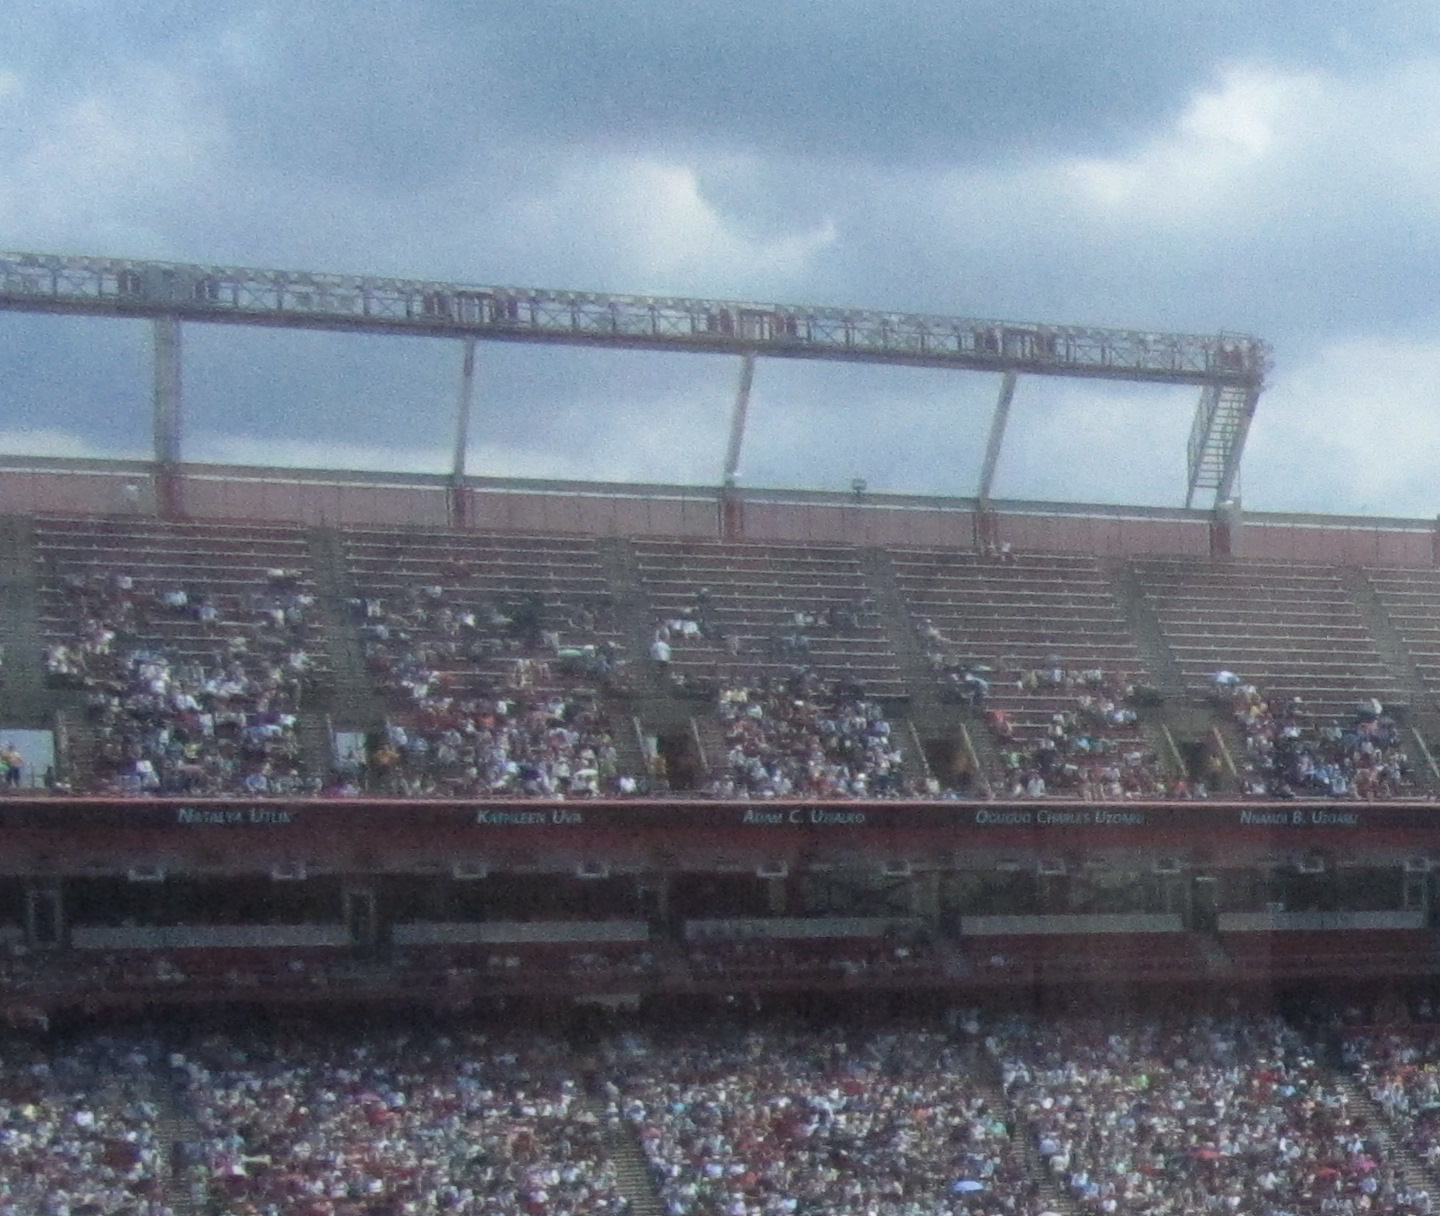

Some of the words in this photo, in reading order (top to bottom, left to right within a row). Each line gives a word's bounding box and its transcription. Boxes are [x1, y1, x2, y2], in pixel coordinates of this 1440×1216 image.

[476, 808, 546, 824] KATHLEEN
[743, 808, 782, 824] ADAM
[1036, 809, 1089, 825] CHARLES
[1240, 810, 1287, 825] NNAMDI
